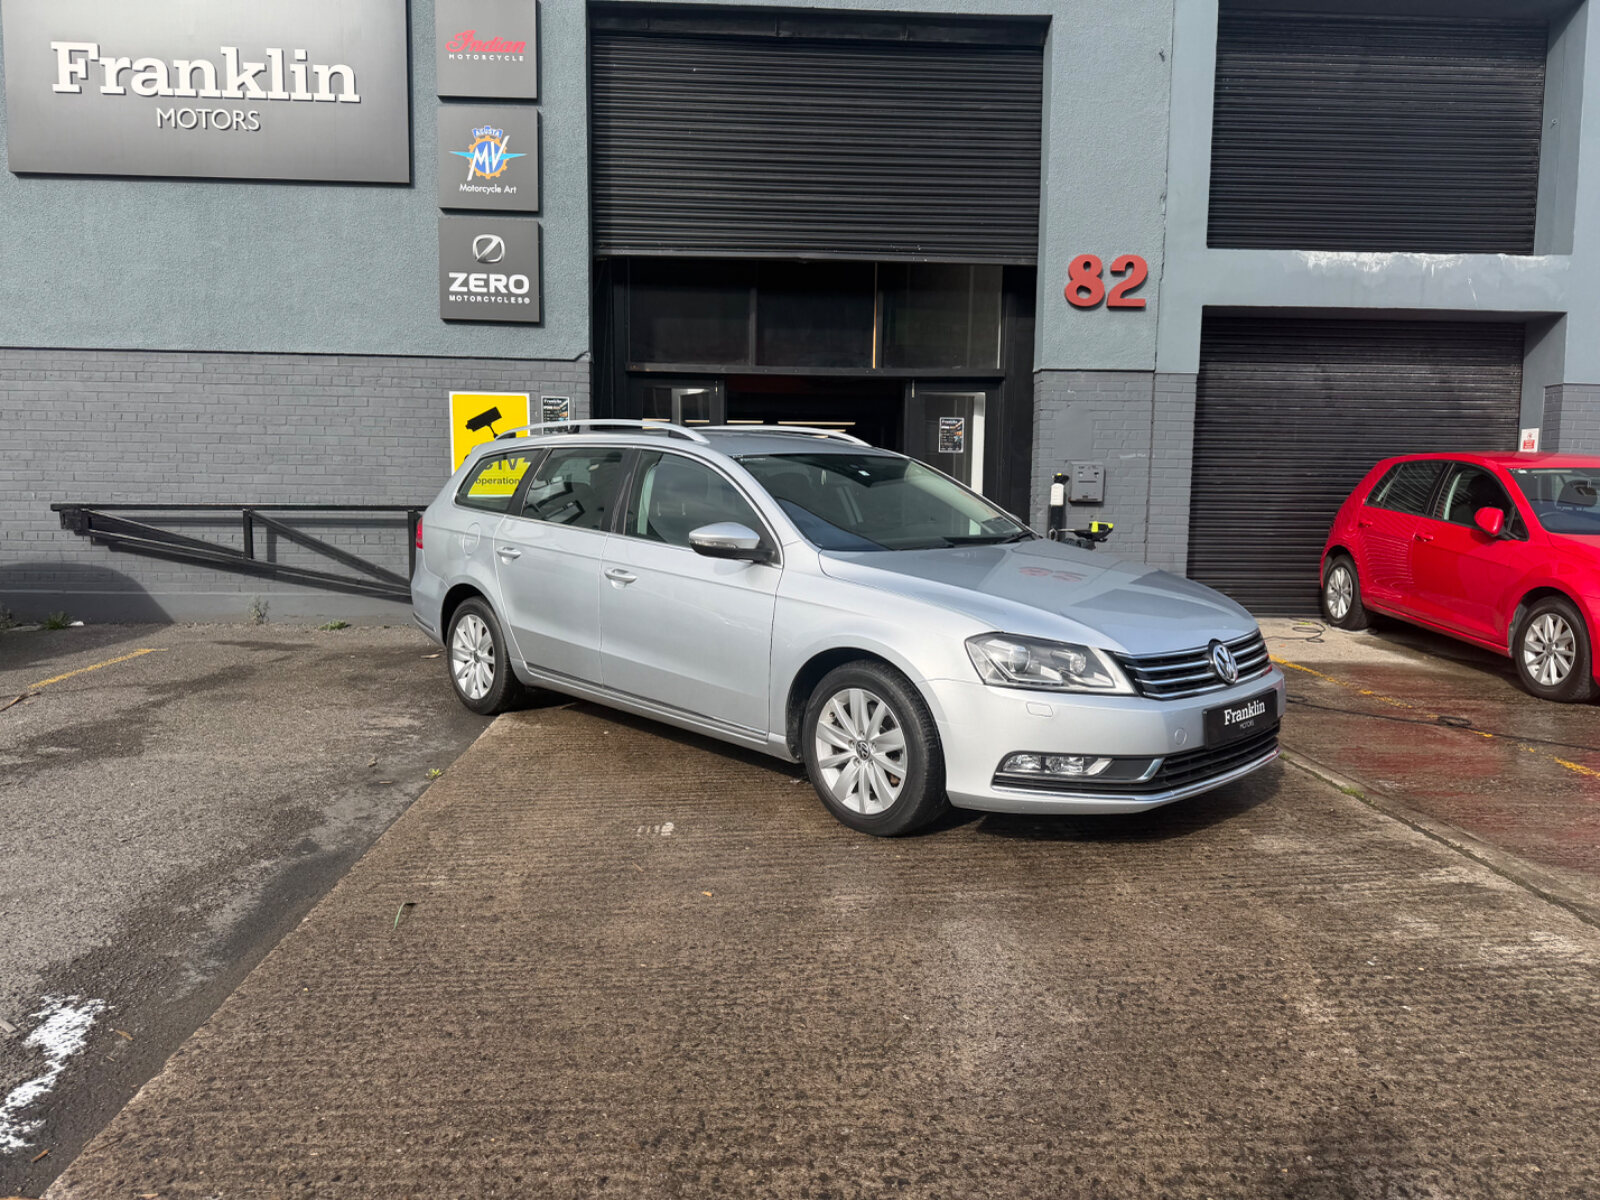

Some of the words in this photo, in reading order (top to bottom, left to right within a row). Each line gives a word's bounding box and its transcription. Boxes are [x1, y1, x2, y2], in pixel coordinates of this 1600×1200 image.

[445, 29, 526, 53] Indian
[448, 53, 524, 62] MOTORCYCLE
[50, 41, 361, 102] Franklin
[156, 107, 261, 131] MOTORS
[467, 135, 510, 181] MV
[459, 184, 501, 194] Motorcycle
[503, 185, 517, 194] Art
[448, 272, 530, 294] ZERO
[1064, 253, 1148, 310] 82
[475, 476, 520, 486] operation
[1224, 700, 1265, 725] Franklin
